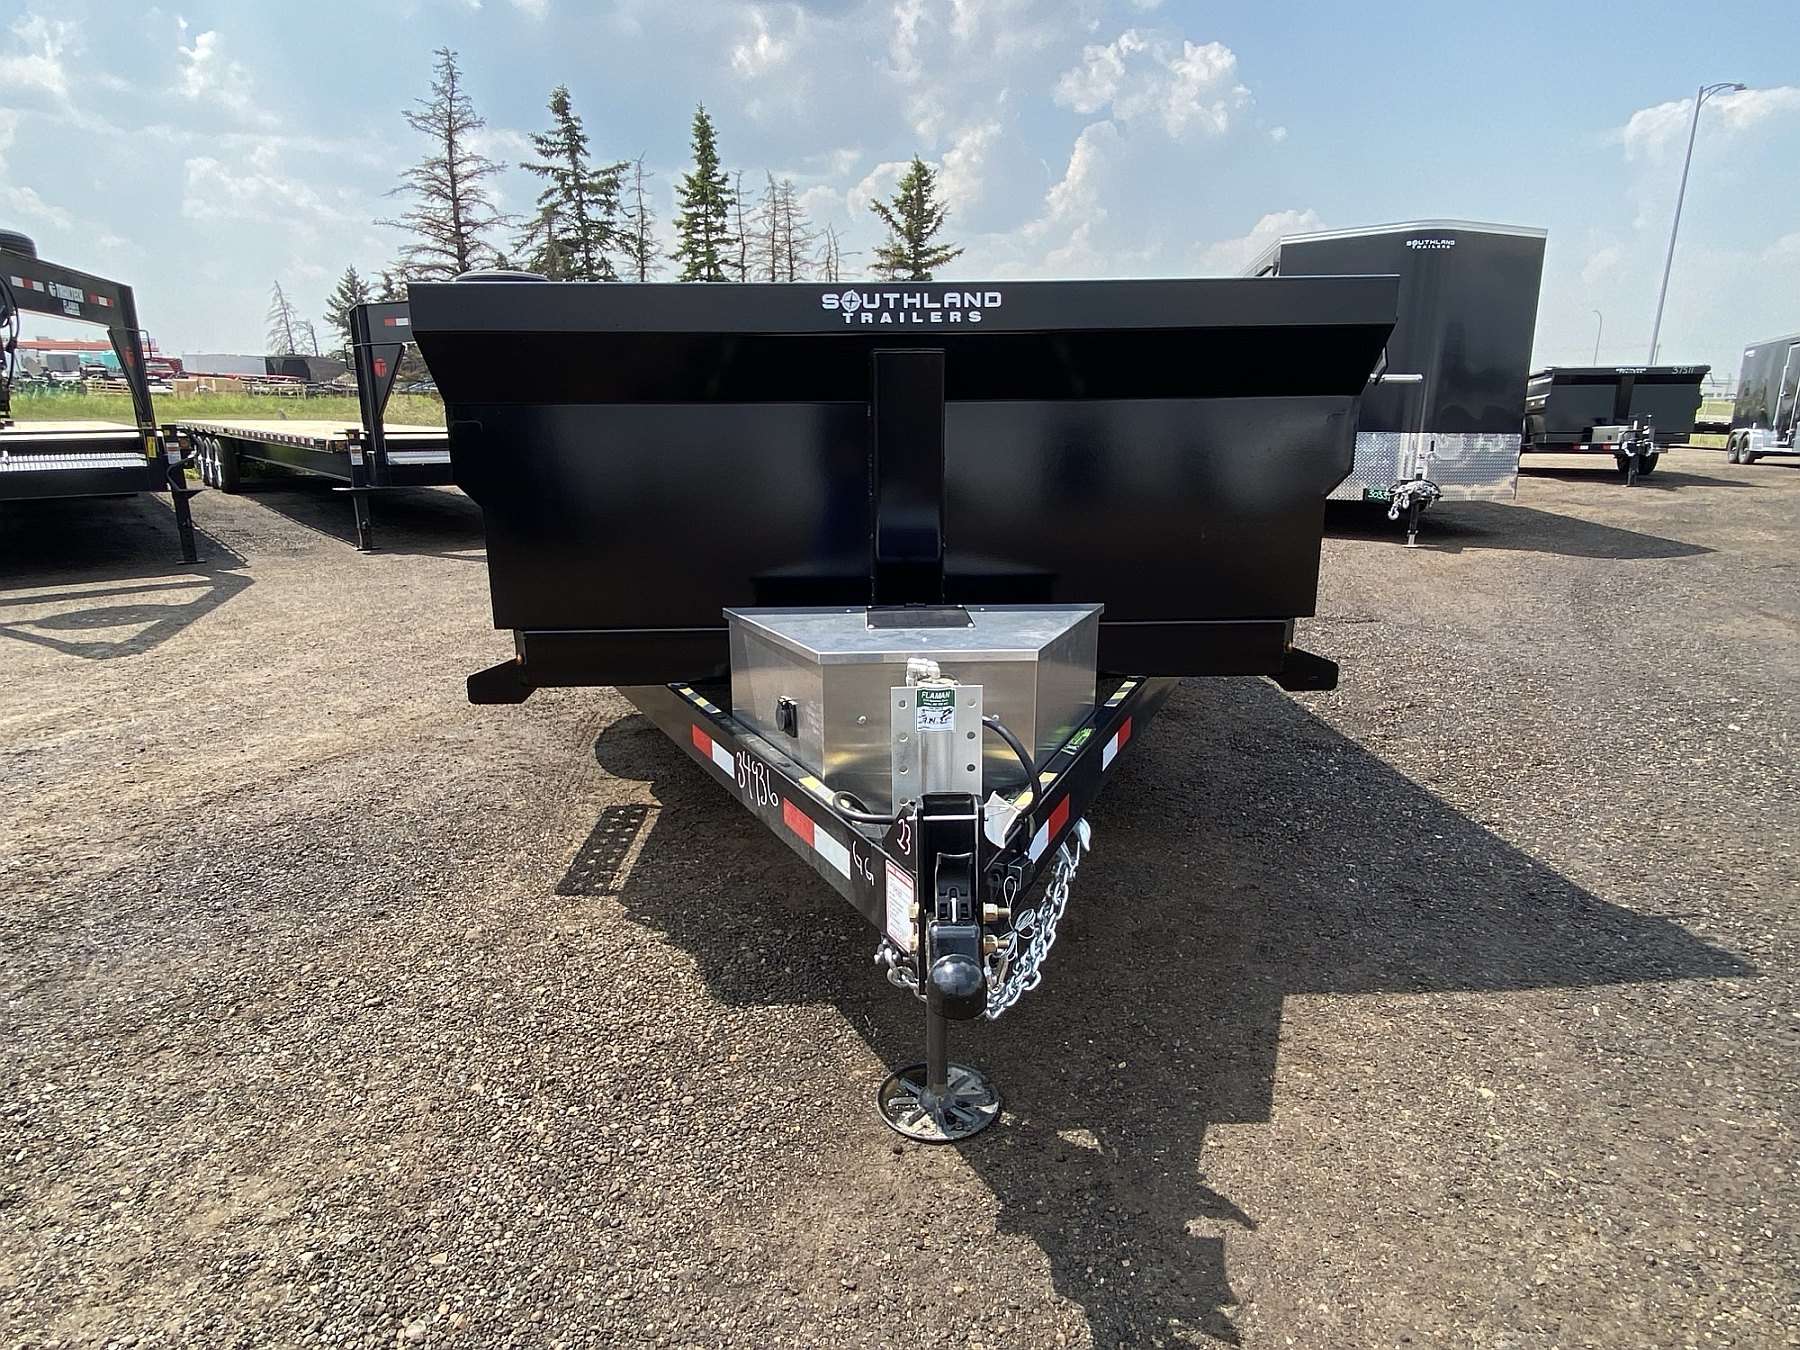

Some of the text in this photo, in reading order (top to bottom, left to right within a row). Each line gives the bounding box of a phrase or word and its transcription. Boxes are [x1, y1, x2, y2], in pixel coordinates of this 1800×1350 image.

[821, 290, 1002, 311] SOUTHLAND
[842, 311, 983, 323] TRAILERS
[921, 691, 951, 700] FLAMAN
[736, 750, 779, 808] 34936
